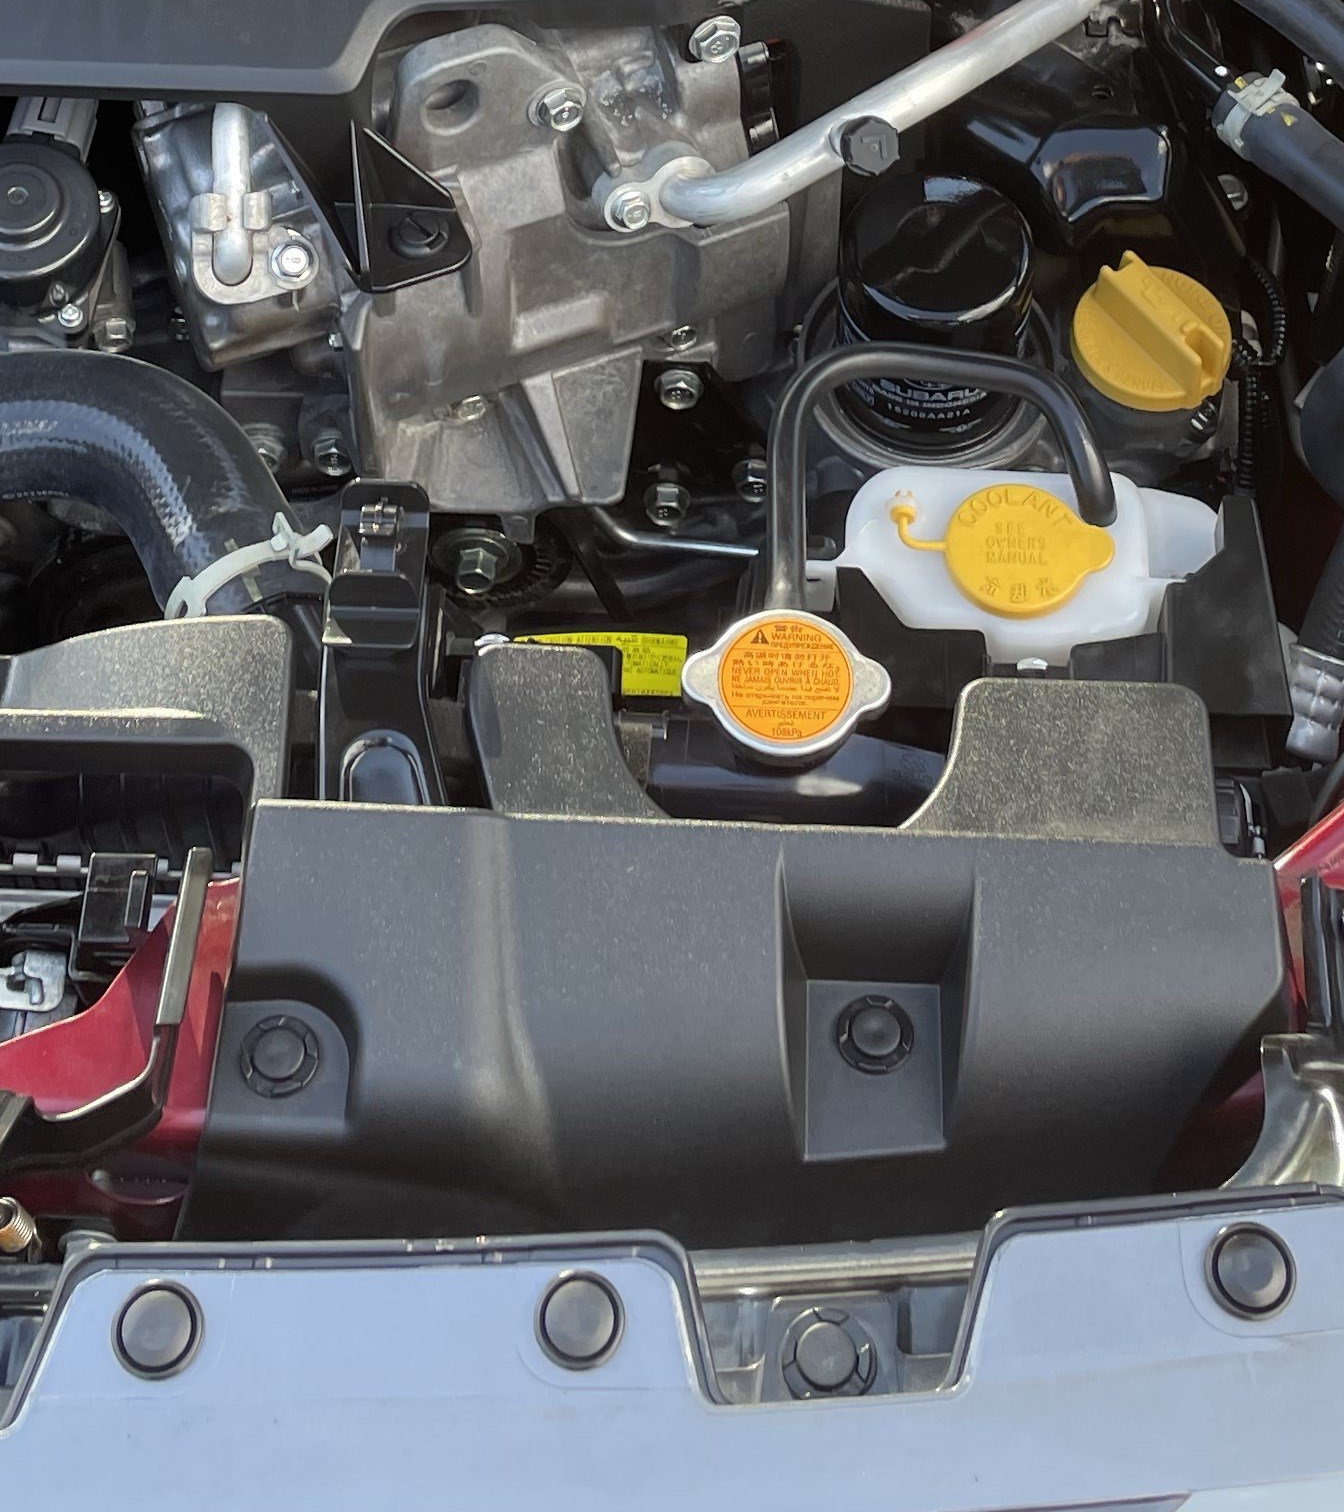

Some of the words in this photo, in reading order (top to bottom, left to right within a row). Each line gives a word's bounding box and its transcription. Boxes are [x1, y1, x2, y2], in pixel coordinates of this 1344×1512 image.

[879, 378, 980, 402] SUBARU
[957, 487, 1073, 528] COOLANT
[995, 520, 1026, 534] SEE
[986, 551, 1048, 565] MANUAL
[771, 632, 822, 642] WARNING
[731, 666, 761, 676] NEVER
[763, 666, 788, 676] OPEN
[791, 667, 818, 677] WHEN
[745, 708, 827, 721] AVERTISSEMENT
[771, 727, 803, 738] 108kPa
